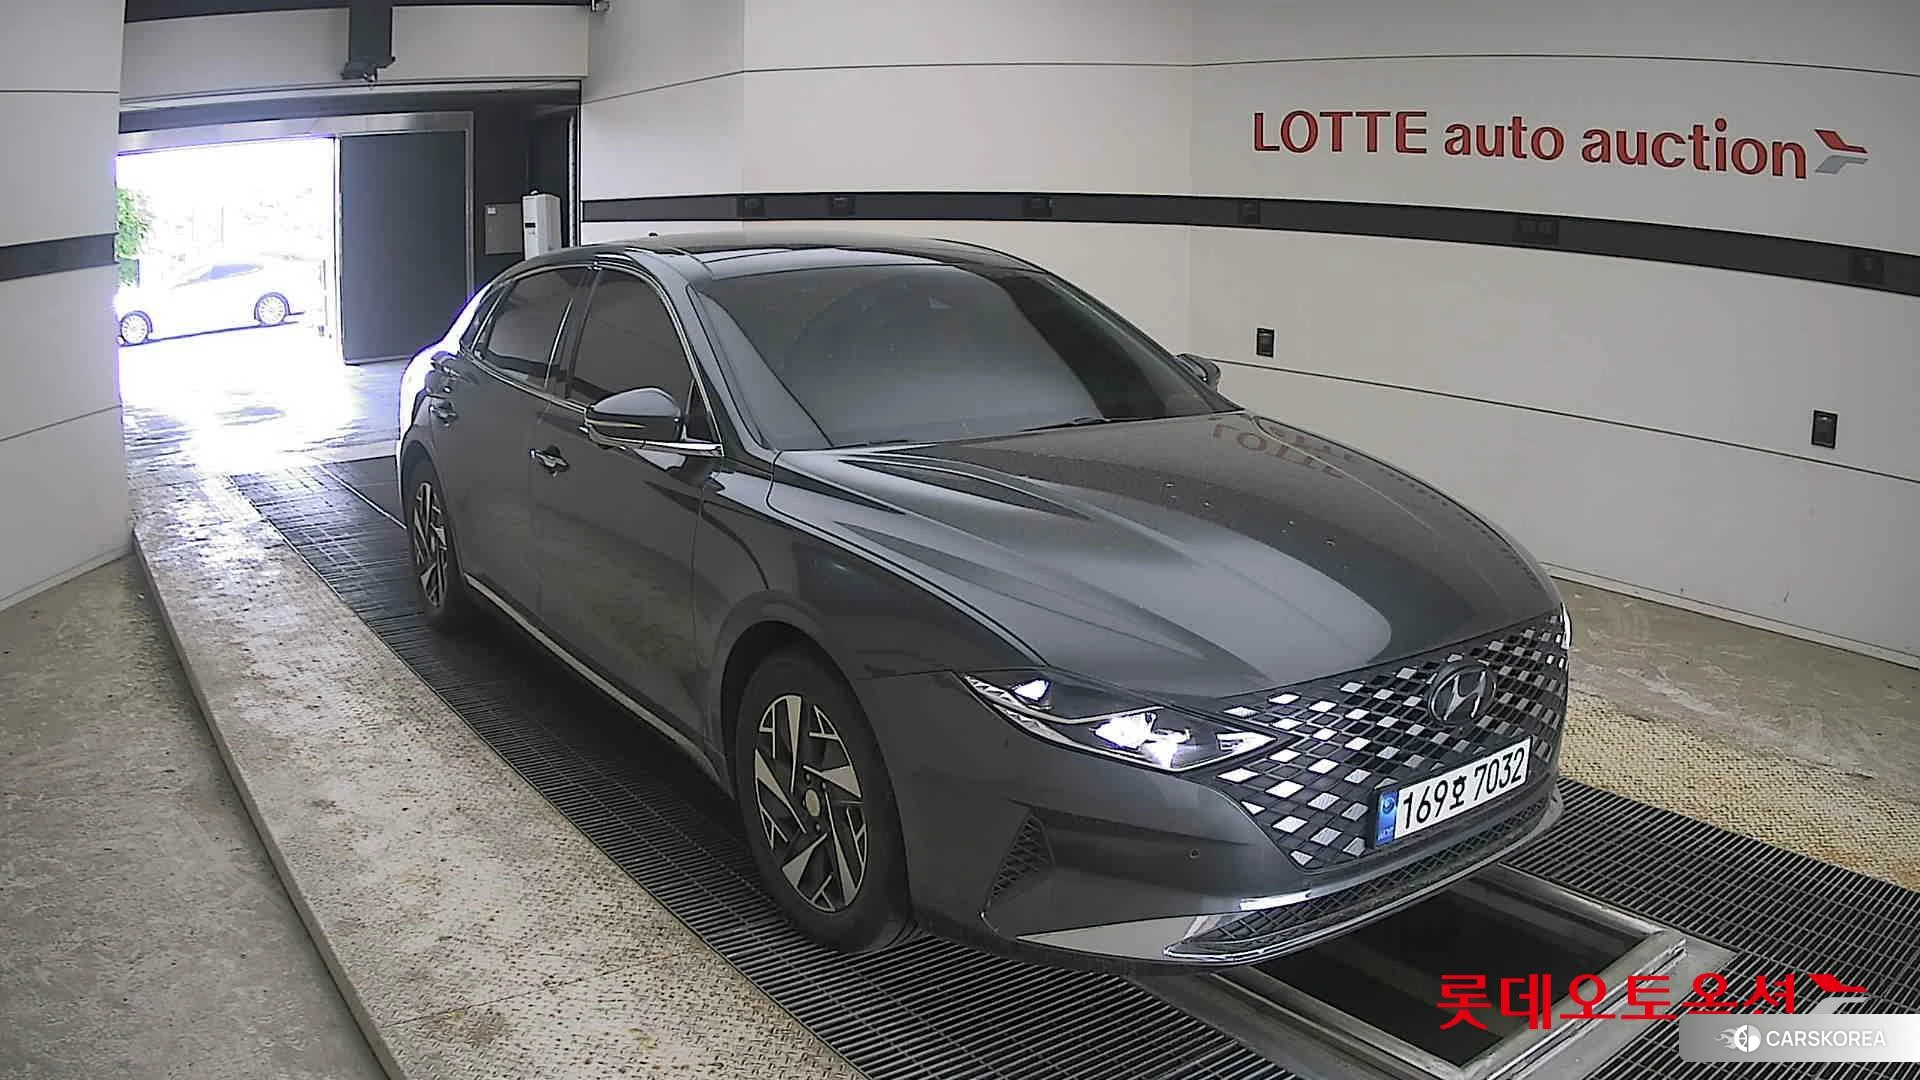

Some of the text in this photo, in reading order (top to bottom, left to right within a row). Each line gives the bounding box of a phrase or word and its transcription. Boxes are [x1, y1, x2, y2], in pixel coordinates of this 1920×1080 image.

[1253, 110, 1808, 179] LOTTE auto auction
[1403, 747, 1525, 829] 169호 7032
